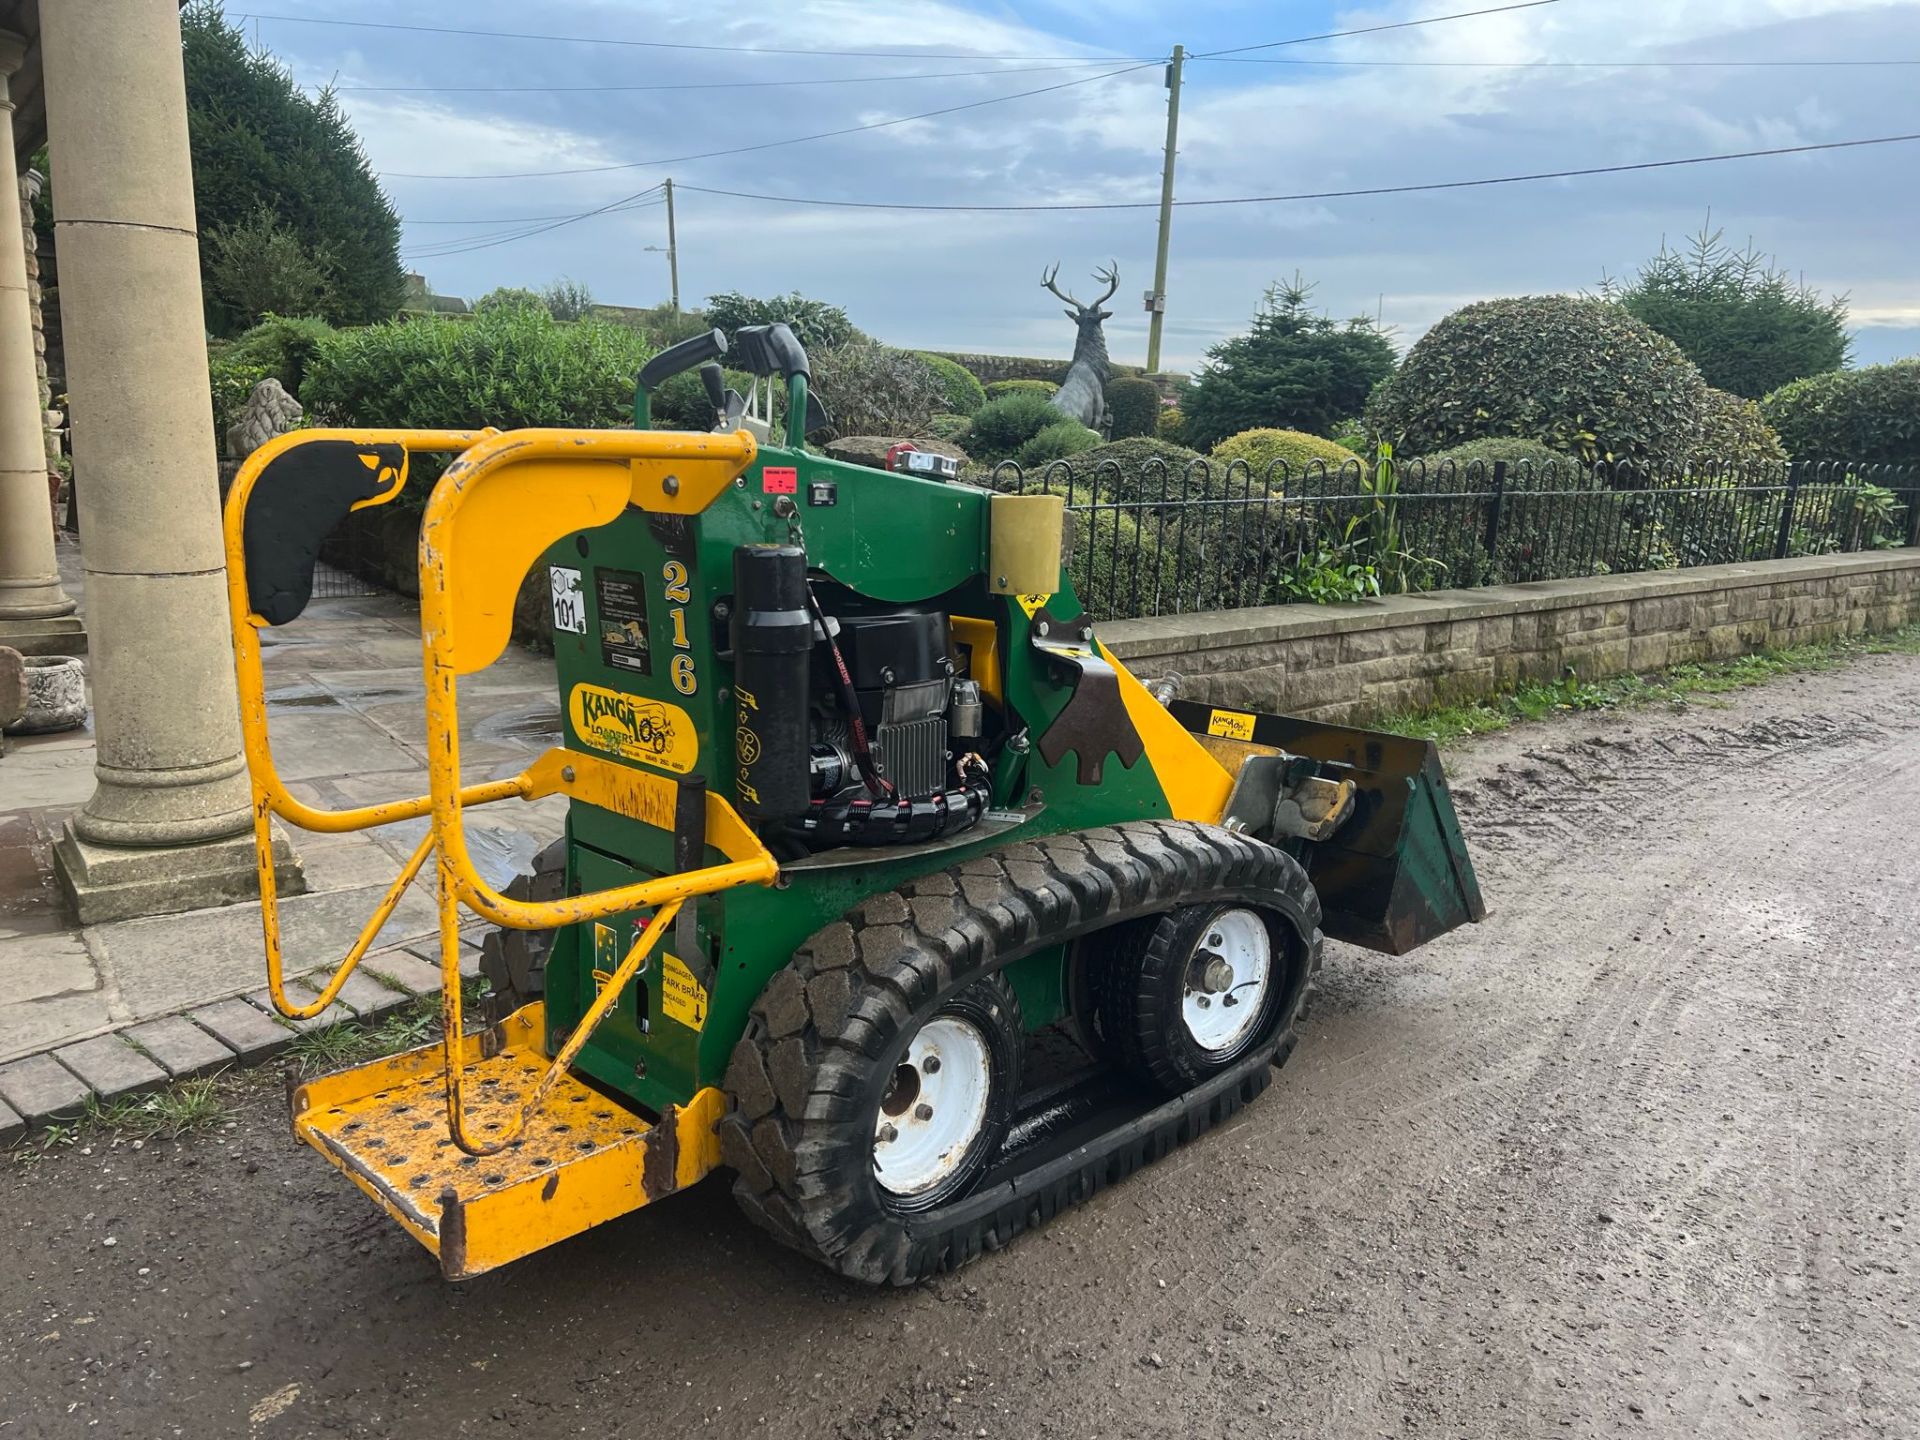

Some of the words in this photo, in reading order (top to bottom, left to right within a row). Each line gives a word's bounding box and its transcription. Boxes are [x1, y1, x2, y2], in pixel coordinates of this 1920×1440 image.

[555, 598, 577, 629] 101
[663, 560, 697, 695] 216
[591, 724, 634, 745] LOADERS
[662, 975, 680, 991] PARK
[682, 984, 705, 1003] BRAKE
